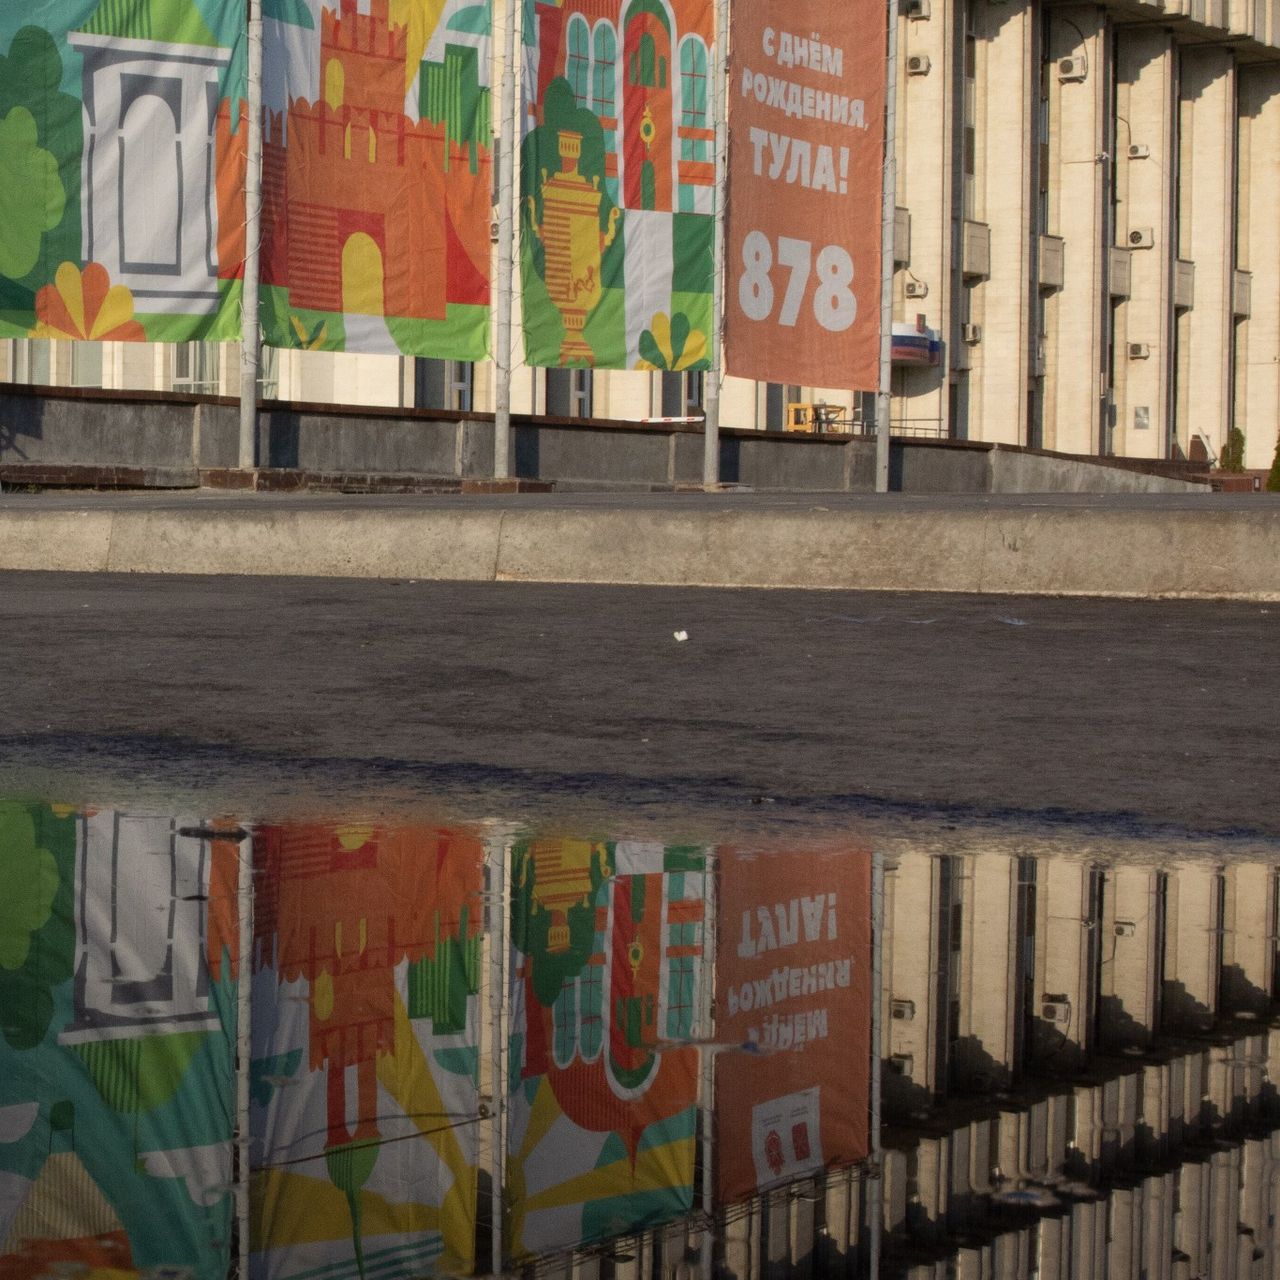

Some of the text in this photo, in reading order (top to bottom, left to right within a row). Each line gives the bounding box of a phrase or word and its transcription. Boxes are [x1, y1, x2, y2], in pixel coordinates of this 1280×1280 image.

[762, 26, 843, 78] С ДНЁМ
[741, 67, 869, 131] РОЖДЕНИЯ,
[749, 126, 850, 194] ТУЛА!
[738, 230, 857, 332] 878
